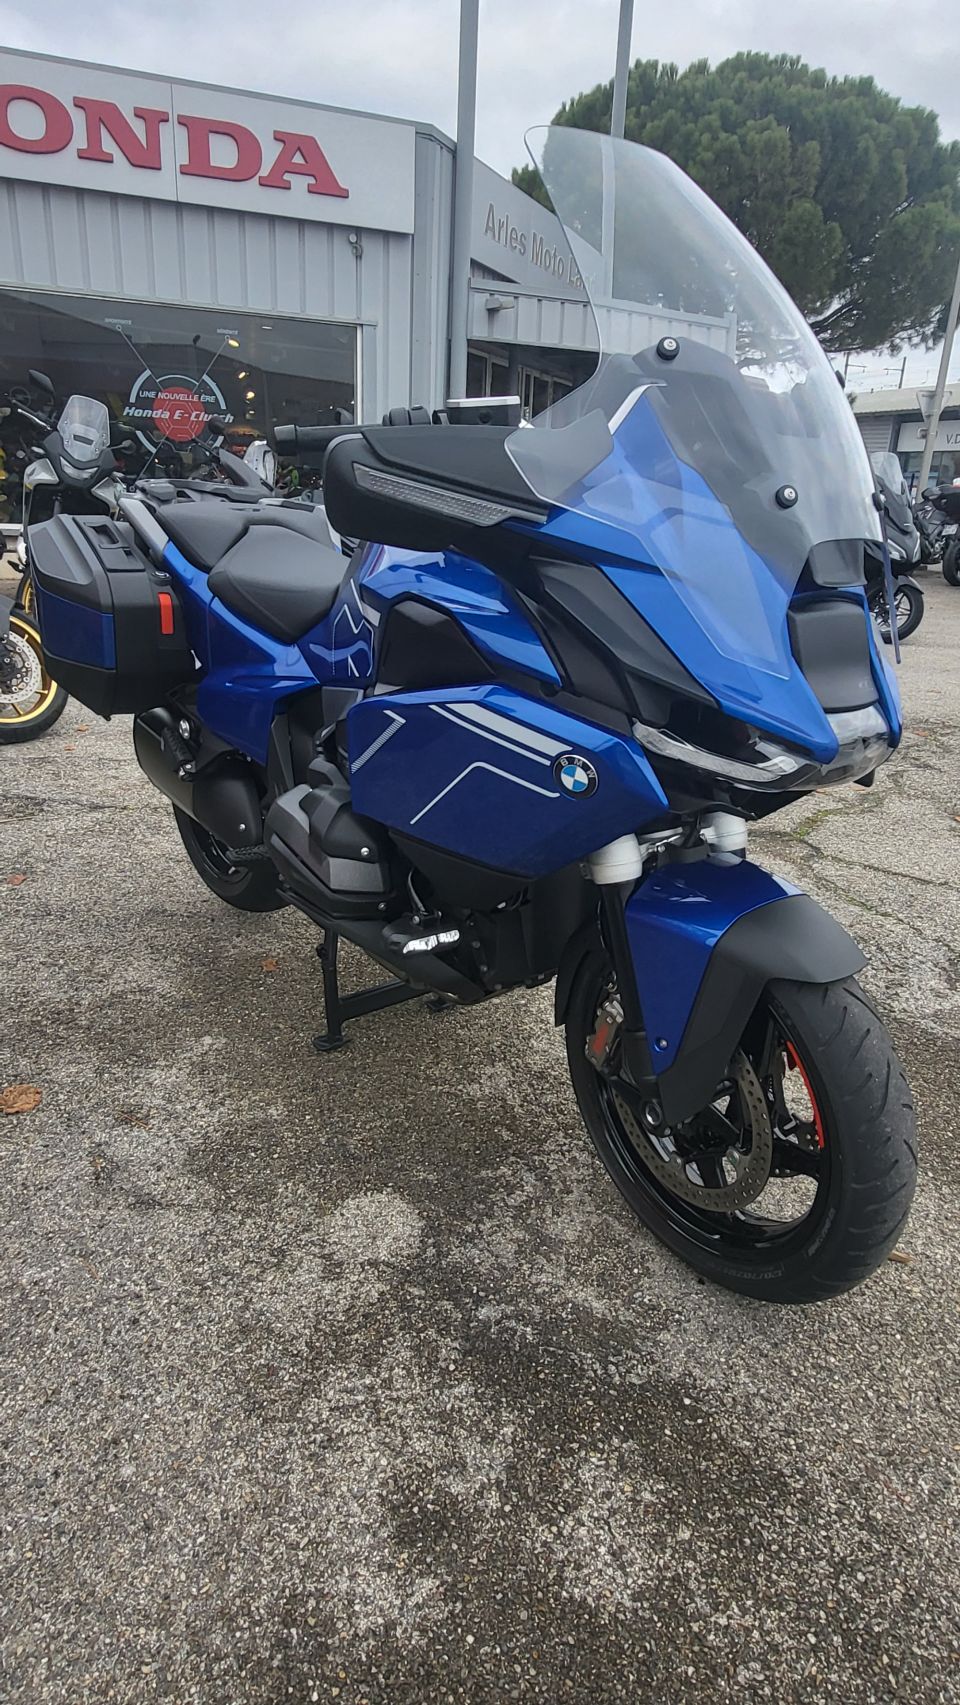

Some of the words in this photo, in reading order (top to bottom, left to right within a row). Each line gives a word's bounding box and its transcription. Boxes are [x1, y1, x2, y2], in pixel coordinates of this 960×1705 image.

[484, 202, 527, 256] Arles
[531, 231, 565, 277] Moto
[567, 255, 586, 289] La
[140, 390, 156, 398] UNE
[158, 391, 199, 401] NOUVELLE
[123, 406, 170, 419] Honda
[173, 410, 234, 423] E-Cluh
[560, 757, 596, 778] BMW
